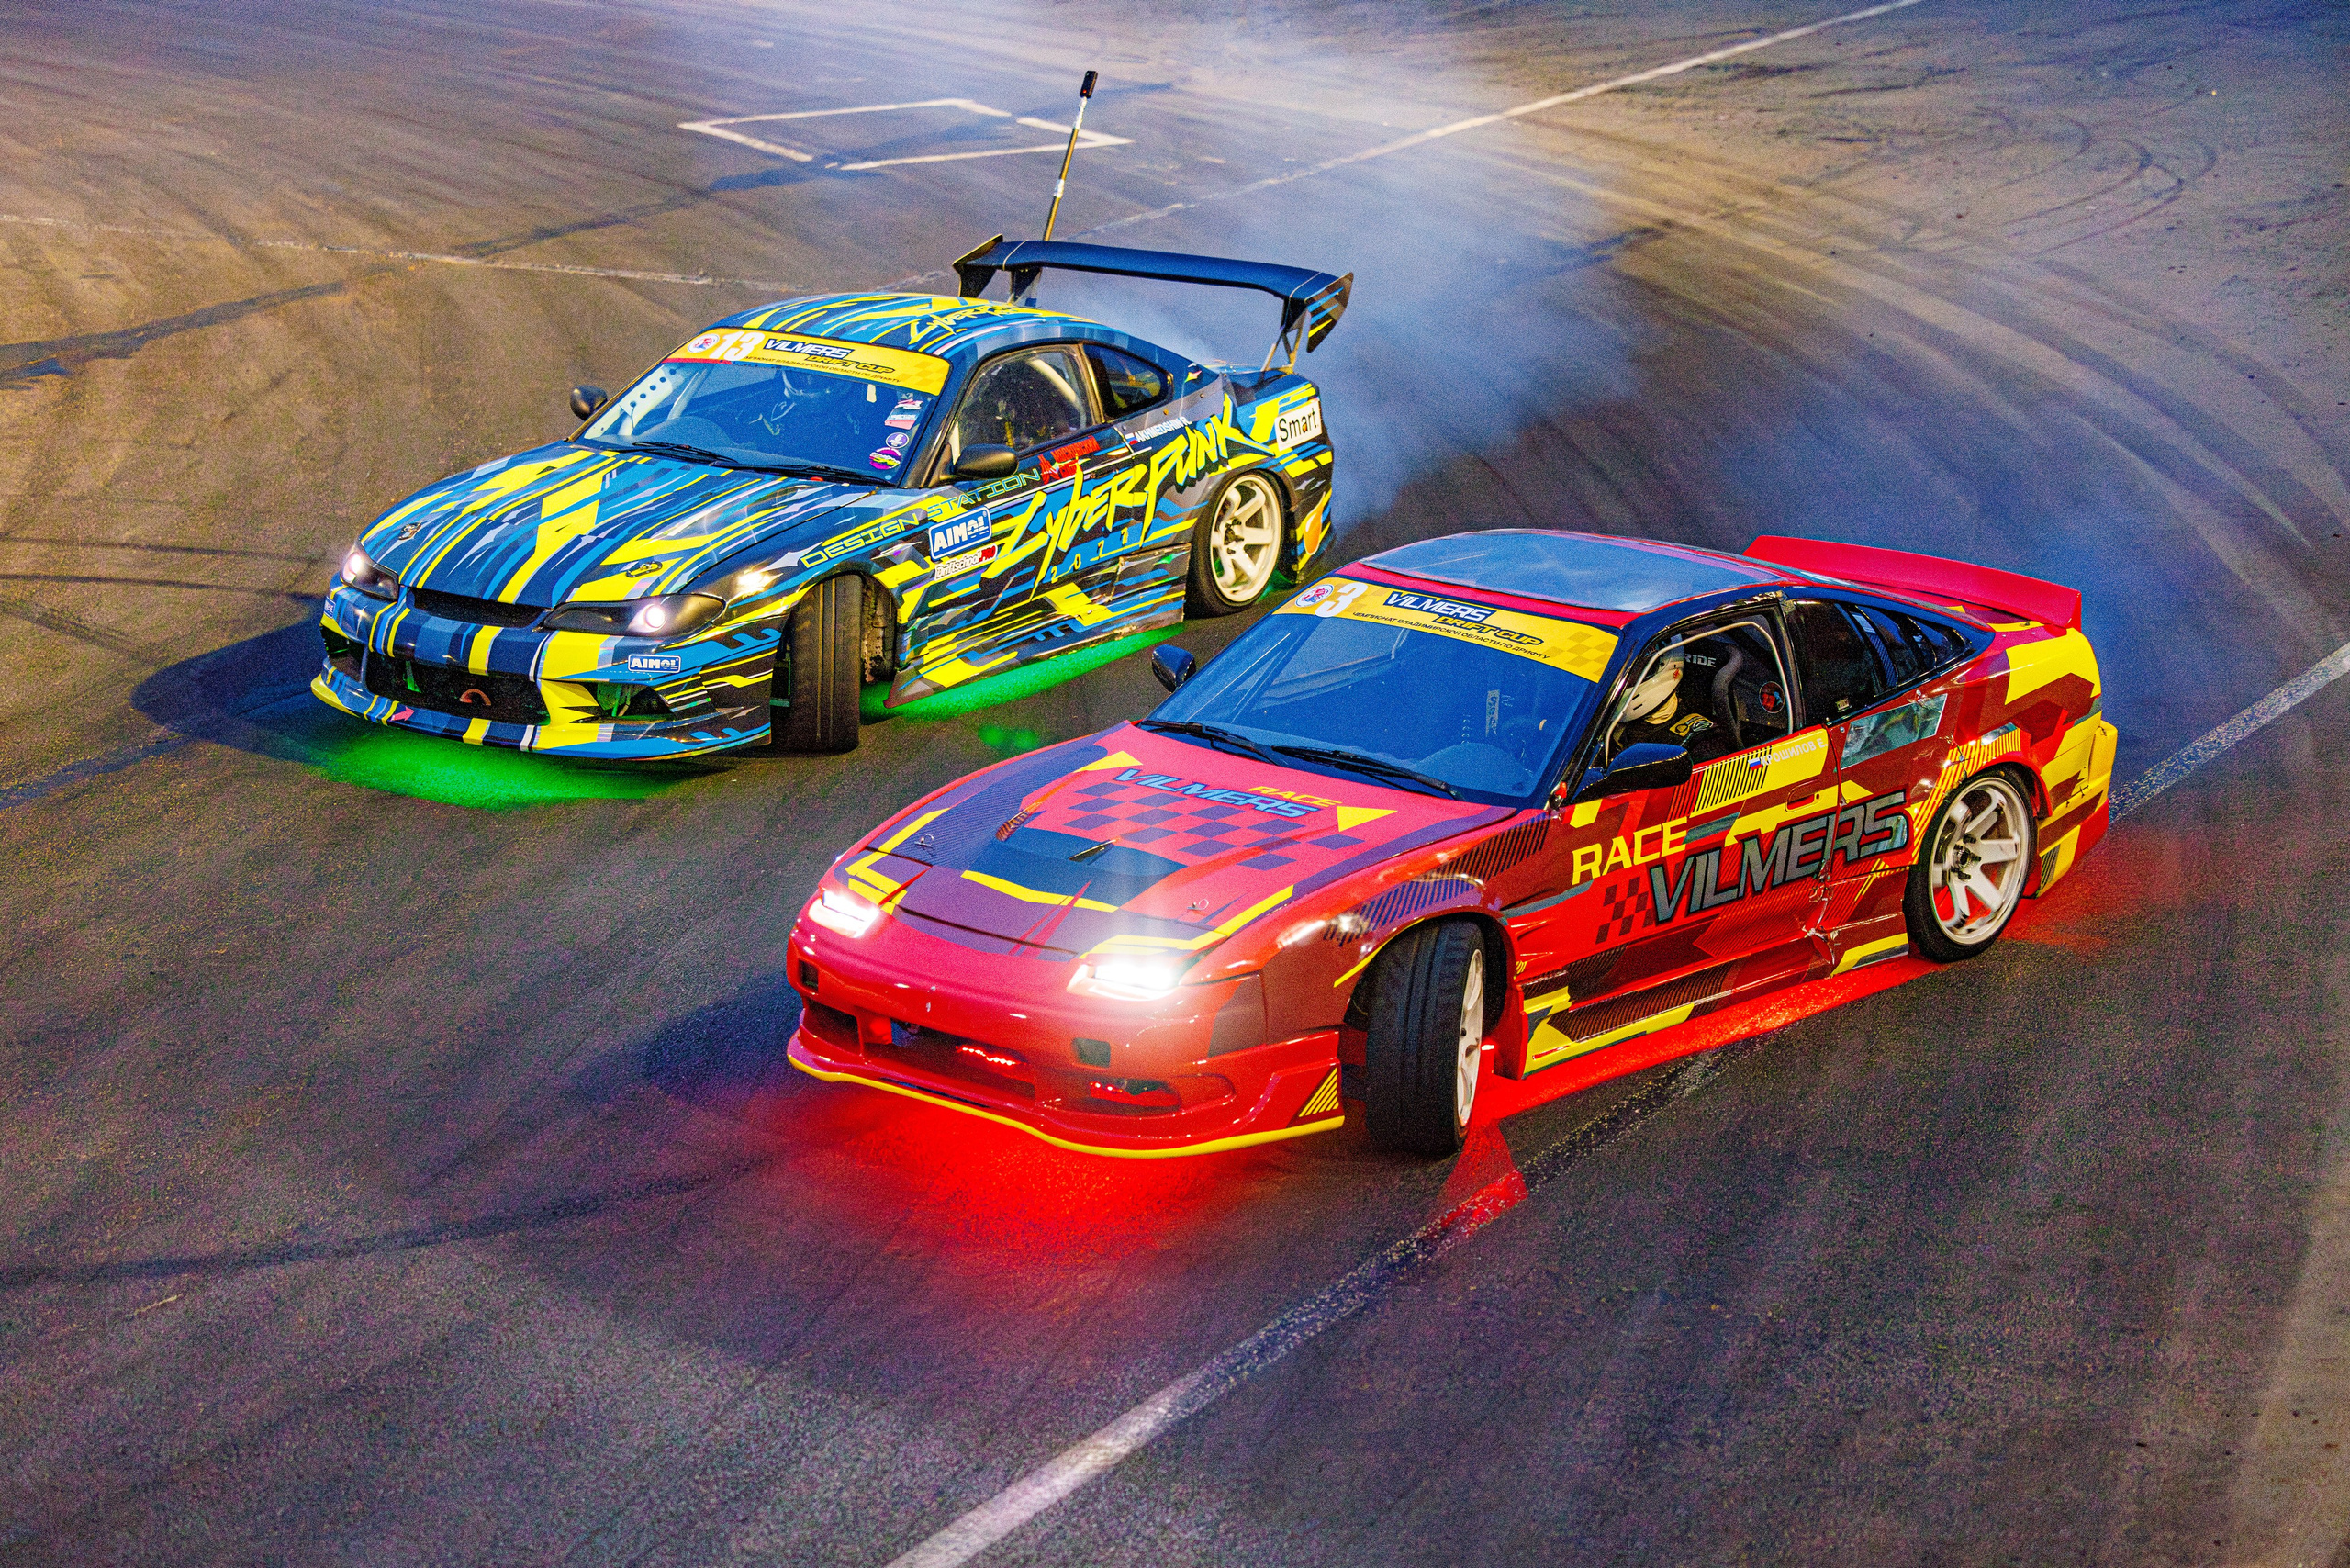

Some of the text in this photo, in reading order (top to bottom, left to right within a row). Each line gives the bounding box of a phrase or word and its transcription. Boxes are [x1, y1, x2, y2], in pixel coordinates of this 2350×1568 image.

[709, 330, 766, 361] 13
[764, 338, 853, 359] VILMERS
[805, 354, 896, 374] DRIFT CUP
[1278, 407, 1317, 442] Smart
[800, 468, 1041, 568] DESIGN STATION
[933, 516, 989, 553] AIMOL
[1315, 582, 1369, 618] 3
[1384, 591, 1494, 622] VILMERS
[1353, 612, 1550, 659] ЧЕМПИОНАТ ВЛАДИМИРСКОЙ ОБЛАСТИ ПО ДРИФТУ
[1433, 615, 1544, 646] DRIFT CUP
[631, 658, 677, 669] AIMOL
[1760, 741, 1817, 767] КРОШИЛОВ
[1113, 767, 1322, 818] VILMERS
[1247, 786, 1342, 808] RACE
[1572, 816, 1688, 886] RACE
[1649, 788, 1910, 923] VILMERS
